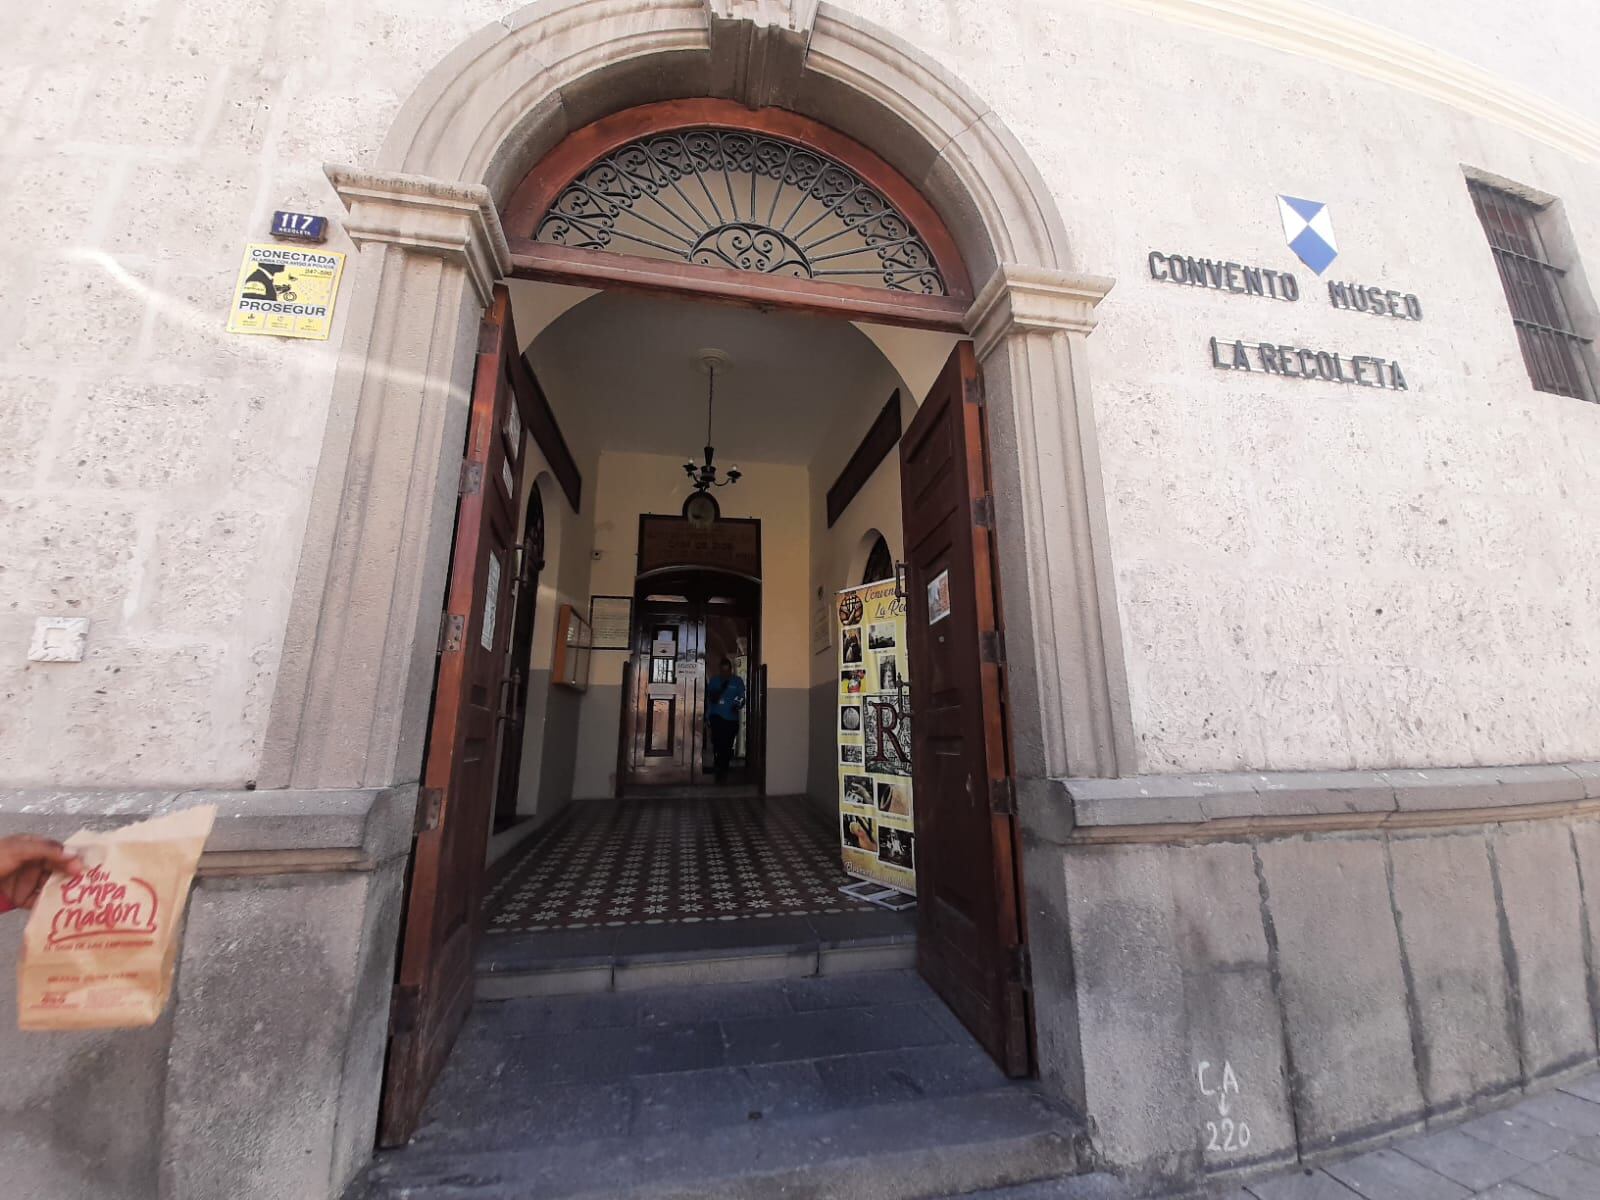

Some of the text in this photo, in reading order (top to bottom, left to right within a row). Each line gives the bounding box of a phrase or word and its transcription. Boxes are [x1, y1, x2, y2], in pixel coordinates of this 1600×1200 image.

[281, 213, 314, 230] 117
[278, 227, 311, 236] RECOLETA
[252, 249, 336, 265] CONECTADA
[1149, 251, 1423, 321] CONVENTO MUSEO
[239, 300, 326, 316] PROSEGUR
[1210, 336, 1408, 391] LA RECOLETA
[864, 586, 898, 603] Conven
[875, 602, 887, 617] La
[1206, 1118, 1250, 1152] 220
